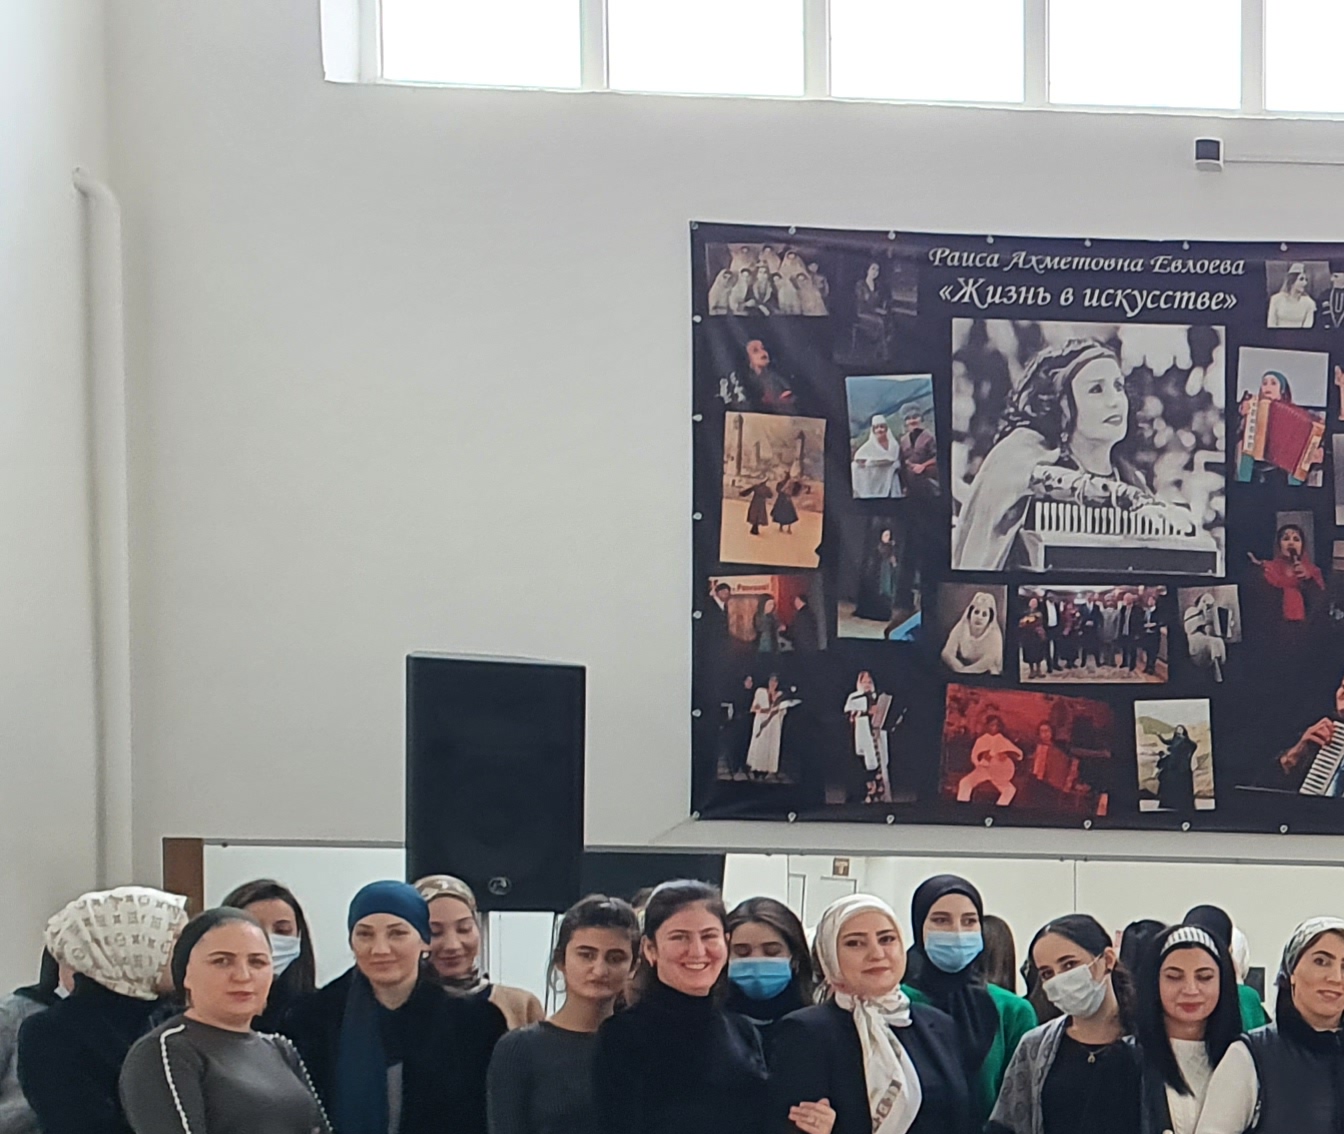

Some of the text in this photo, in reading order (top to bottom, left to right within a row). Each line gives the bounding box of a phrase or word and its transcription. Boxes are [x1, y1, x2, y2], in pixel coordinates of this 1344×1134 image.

[928, 247, 1246, 276] Раиса Ахметовна Евлоева
[938, 277, 1238, 317] «Жизнь в искусстве»
